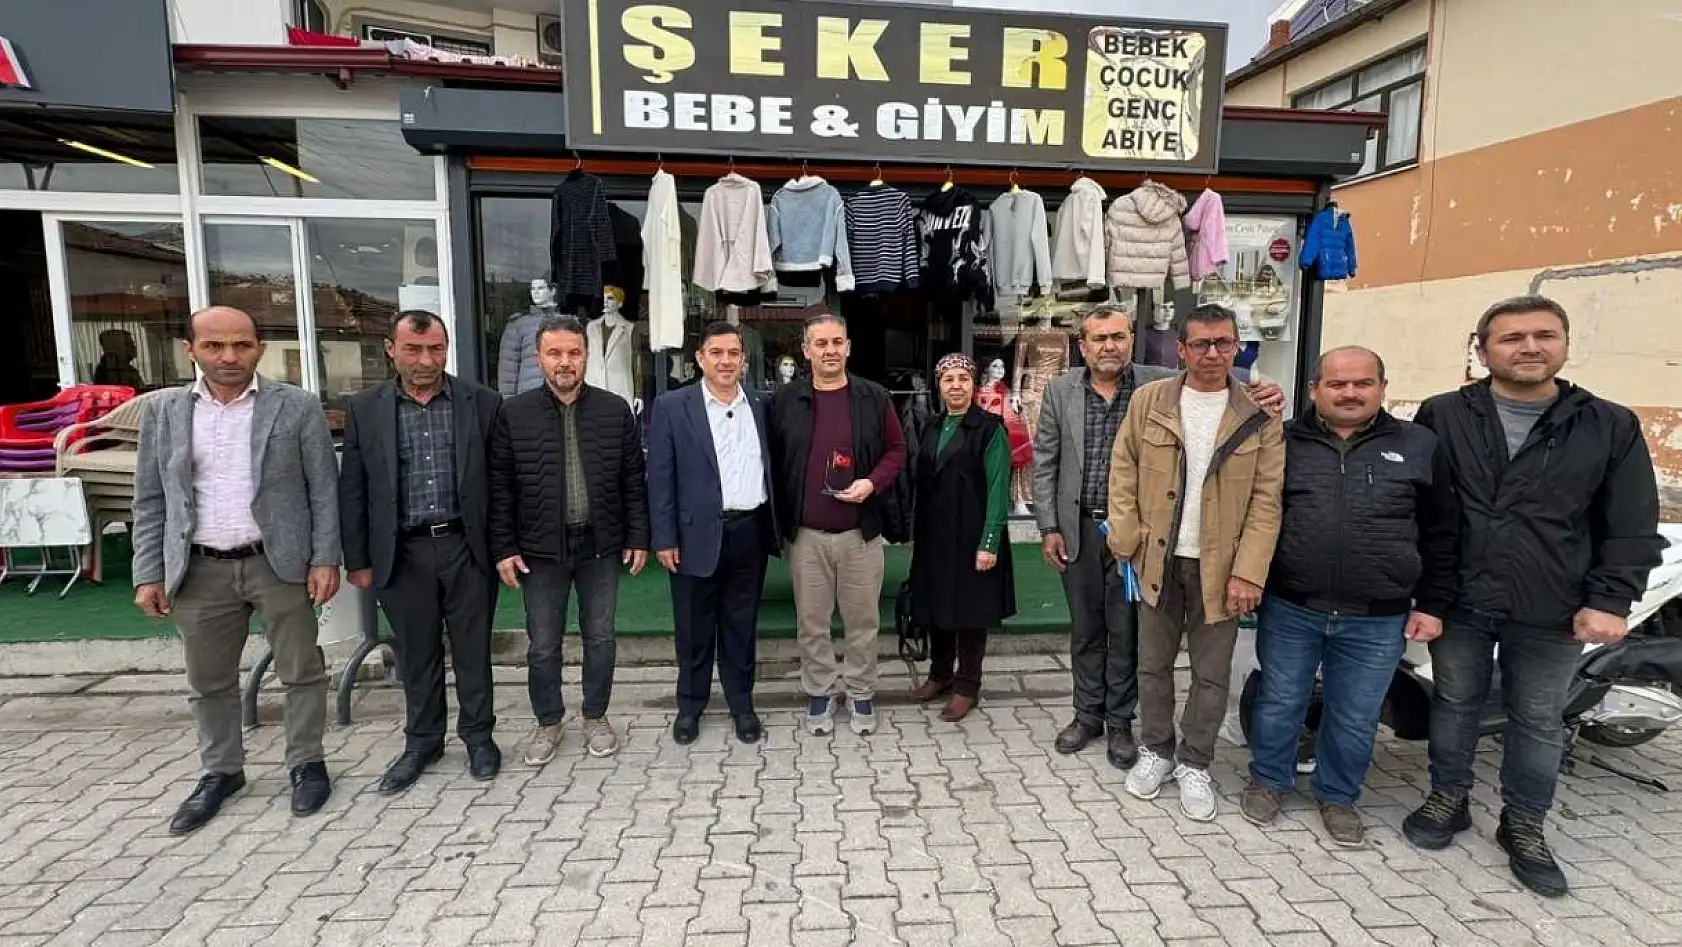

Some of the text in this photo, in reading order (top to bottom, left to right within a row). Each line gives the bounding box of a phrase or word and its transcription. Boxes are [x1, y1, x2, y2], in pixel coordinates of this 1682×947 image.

[621, 4, 1069, 89] ŞEKER
[1104, 34, 1189, 58] BEBEK
[1100, 65, 1189, 91] ÇOCUK
[623, 90, 1066, 146] BEBE & GİYİM
